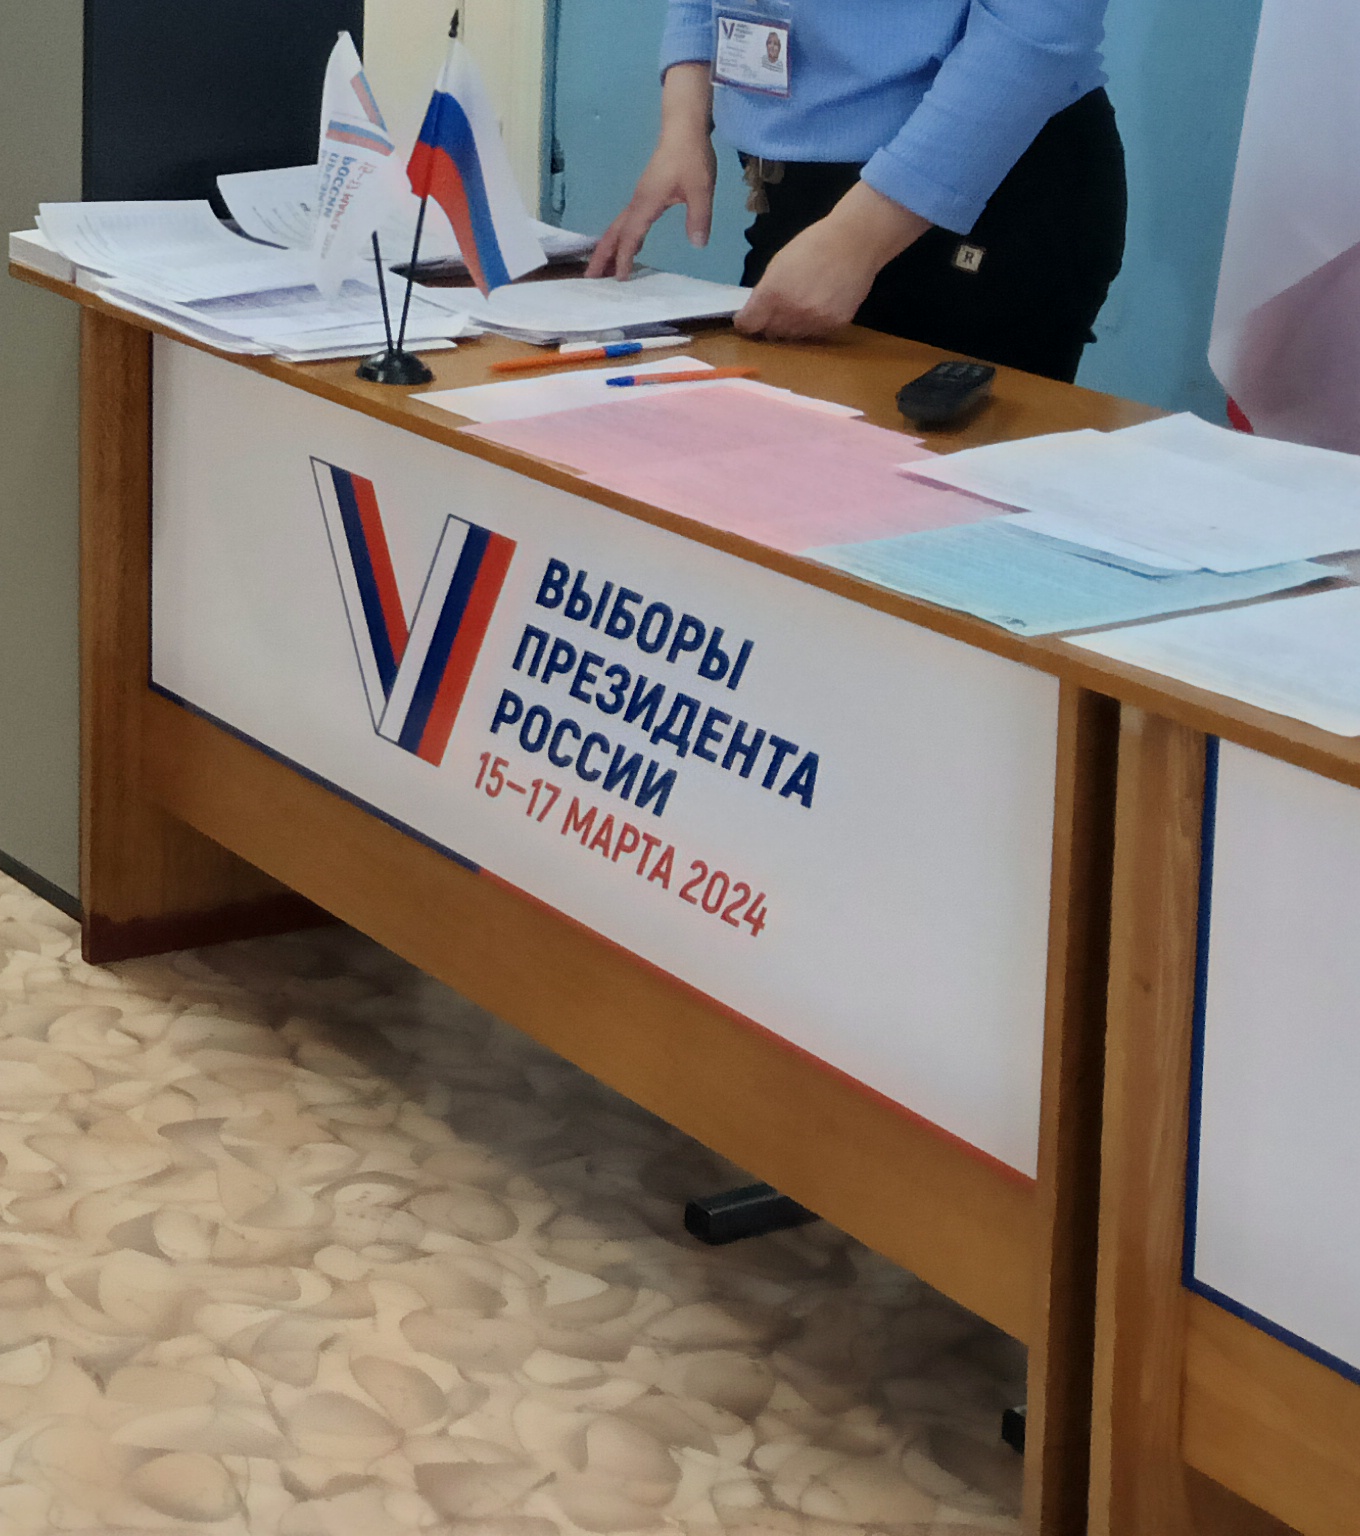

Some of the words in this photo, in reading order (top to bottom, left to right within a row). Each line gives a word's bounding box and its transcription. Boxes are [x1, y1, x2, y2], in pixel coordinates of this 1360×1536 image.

[535, 557, 755, 690] ВЫБОРЫ
[489, 688, 678, 817] РОССИИ
[511, 623, 822, 809] ПРЕЗИДЕНТА
[561, 795, 677, 891] МАРТА
[678, 858, 768, 938] 2024
